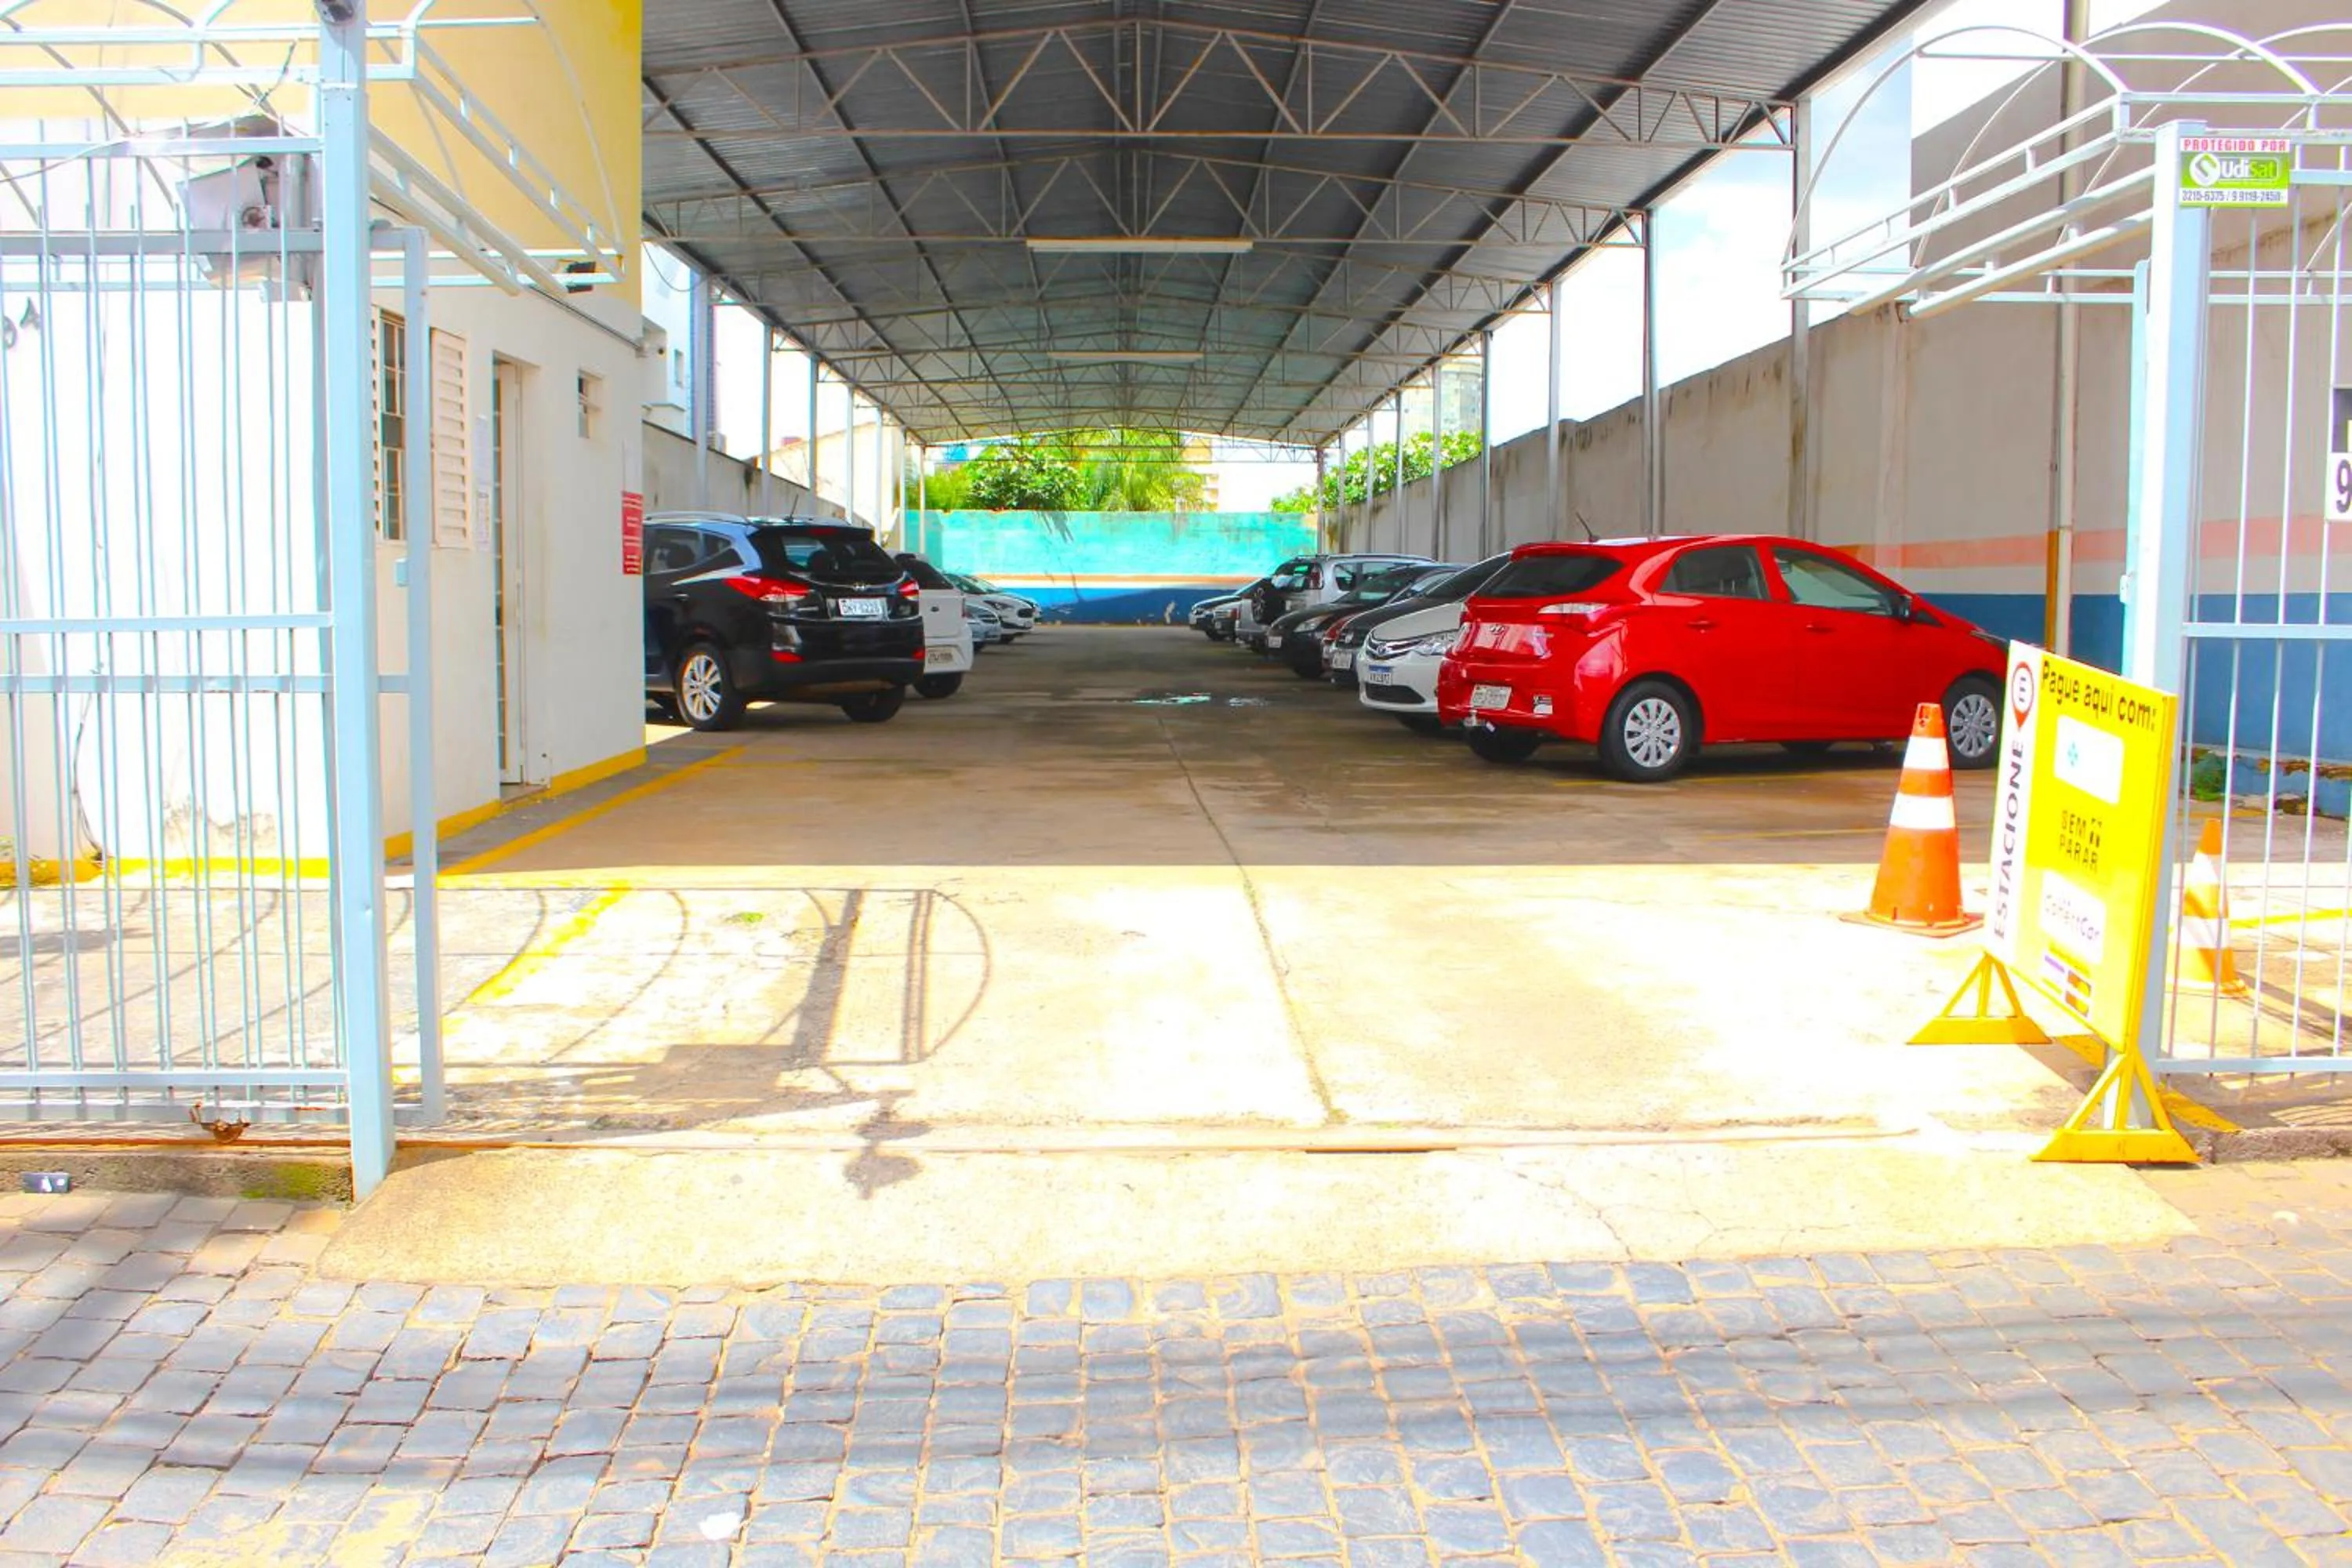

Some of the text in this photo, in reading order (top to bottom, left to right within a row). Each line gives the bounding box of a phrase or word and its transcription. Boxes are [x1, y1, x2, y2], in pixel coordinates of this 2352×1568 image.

[2183, 138, 2286, 151] PROTEGIDO POR
[2221, 158, 2274, 179] UdiSat
[2041, 660, 2158, 732] Pague aqui com:
[1994, 739, 2025, 939] ESTACIONE
[2061, 810, 2086, 840] SEM
[2058, 833, 2100, 874] PARAR
